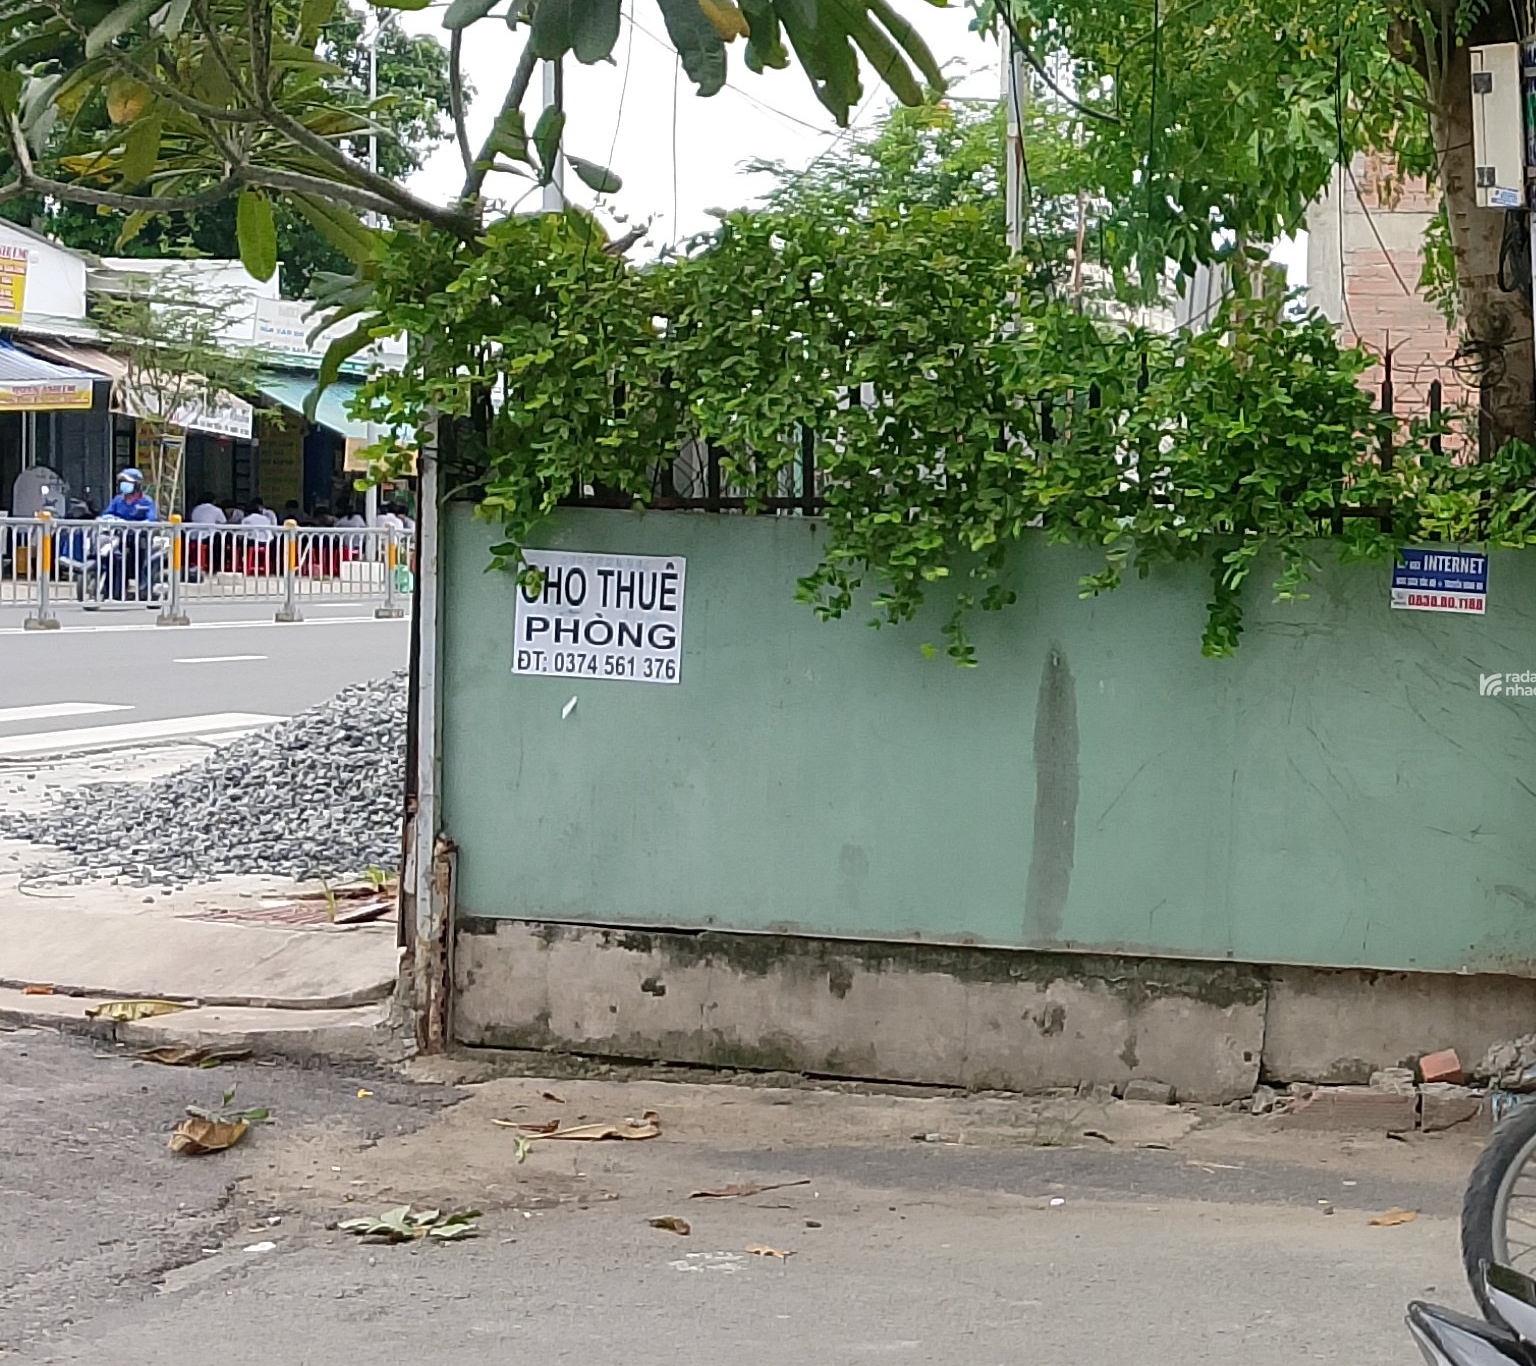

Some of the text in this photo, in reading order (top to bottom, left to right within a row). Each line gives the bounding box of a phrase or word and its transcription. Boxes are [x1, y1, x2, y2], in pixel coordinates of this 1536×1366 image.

[1424, 554, 1485, 575] INTERNET
[597, 562, 678, 612] THUÊ
[526, 613, 676, 650] PHÒNG
[517, 650, 676, 679] ĐT: 0374 561 376
